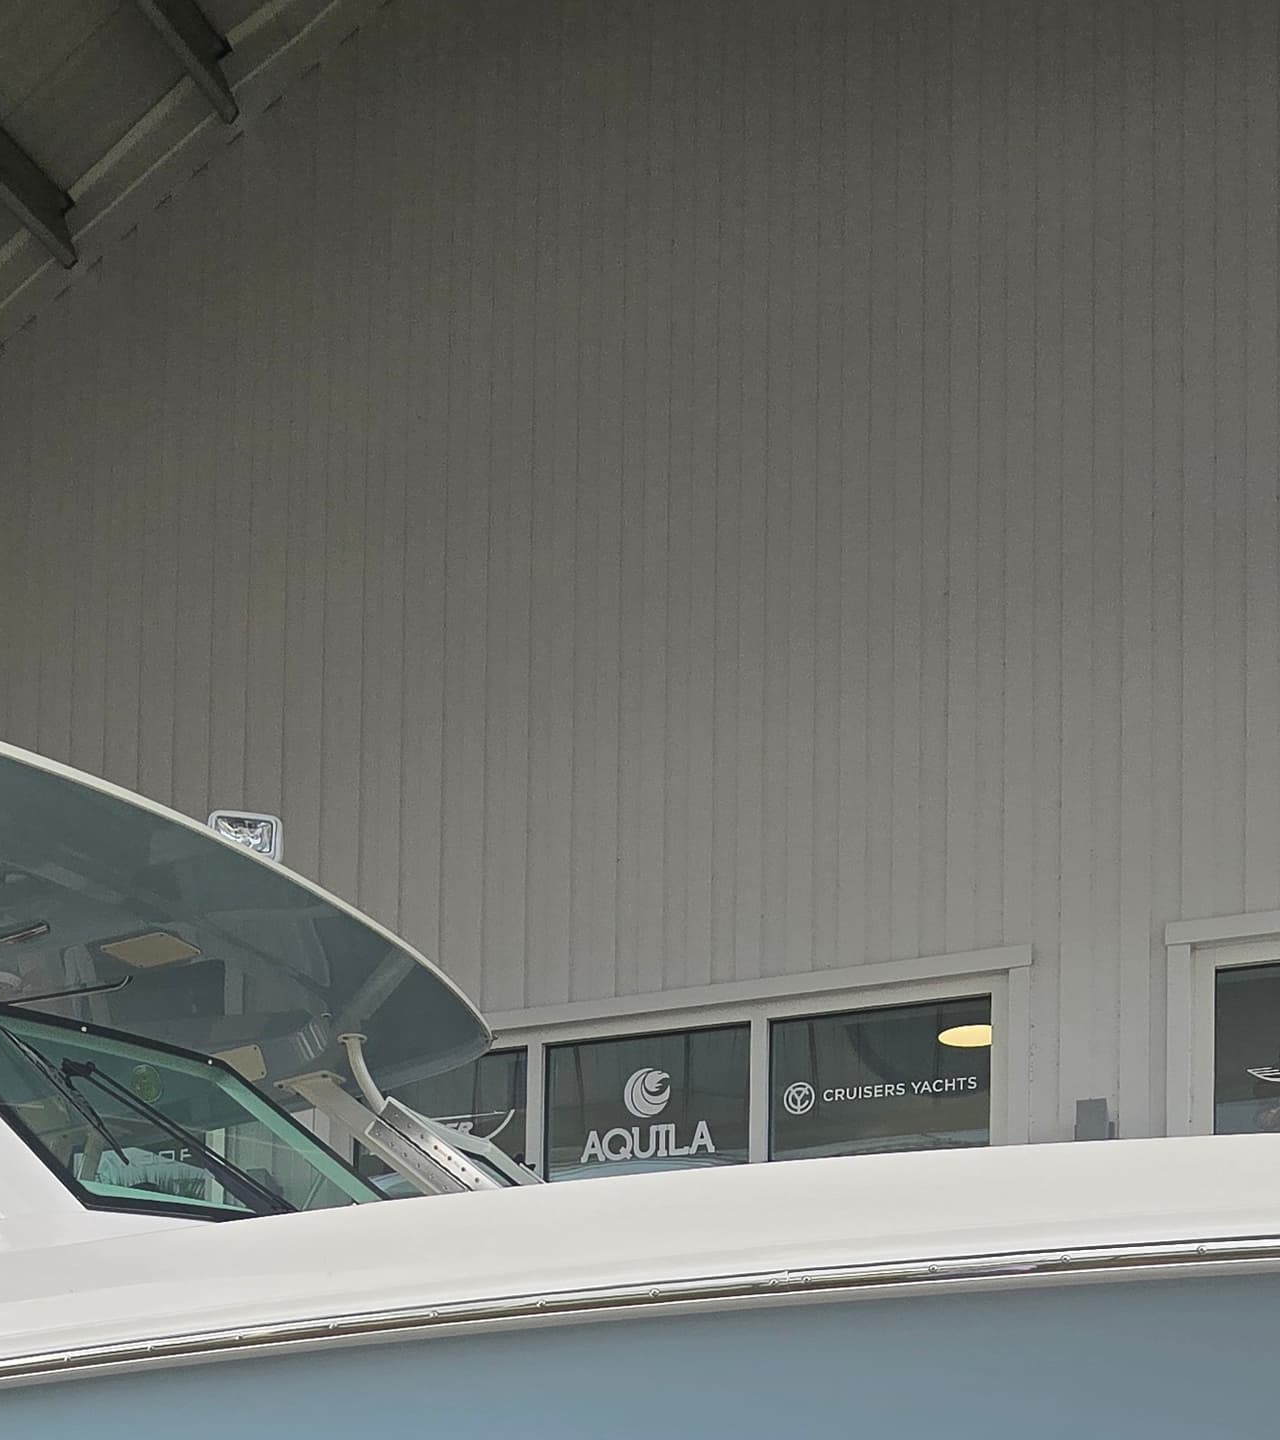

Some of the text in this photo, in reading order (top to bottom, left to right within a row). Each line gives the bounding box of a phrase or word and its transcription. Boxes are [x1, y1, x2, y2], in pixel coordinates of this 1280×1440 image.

[823, 1076, 977, 1102] CRUISERS YACHTS
[580, 1120, 716, 1163] AQUILA
